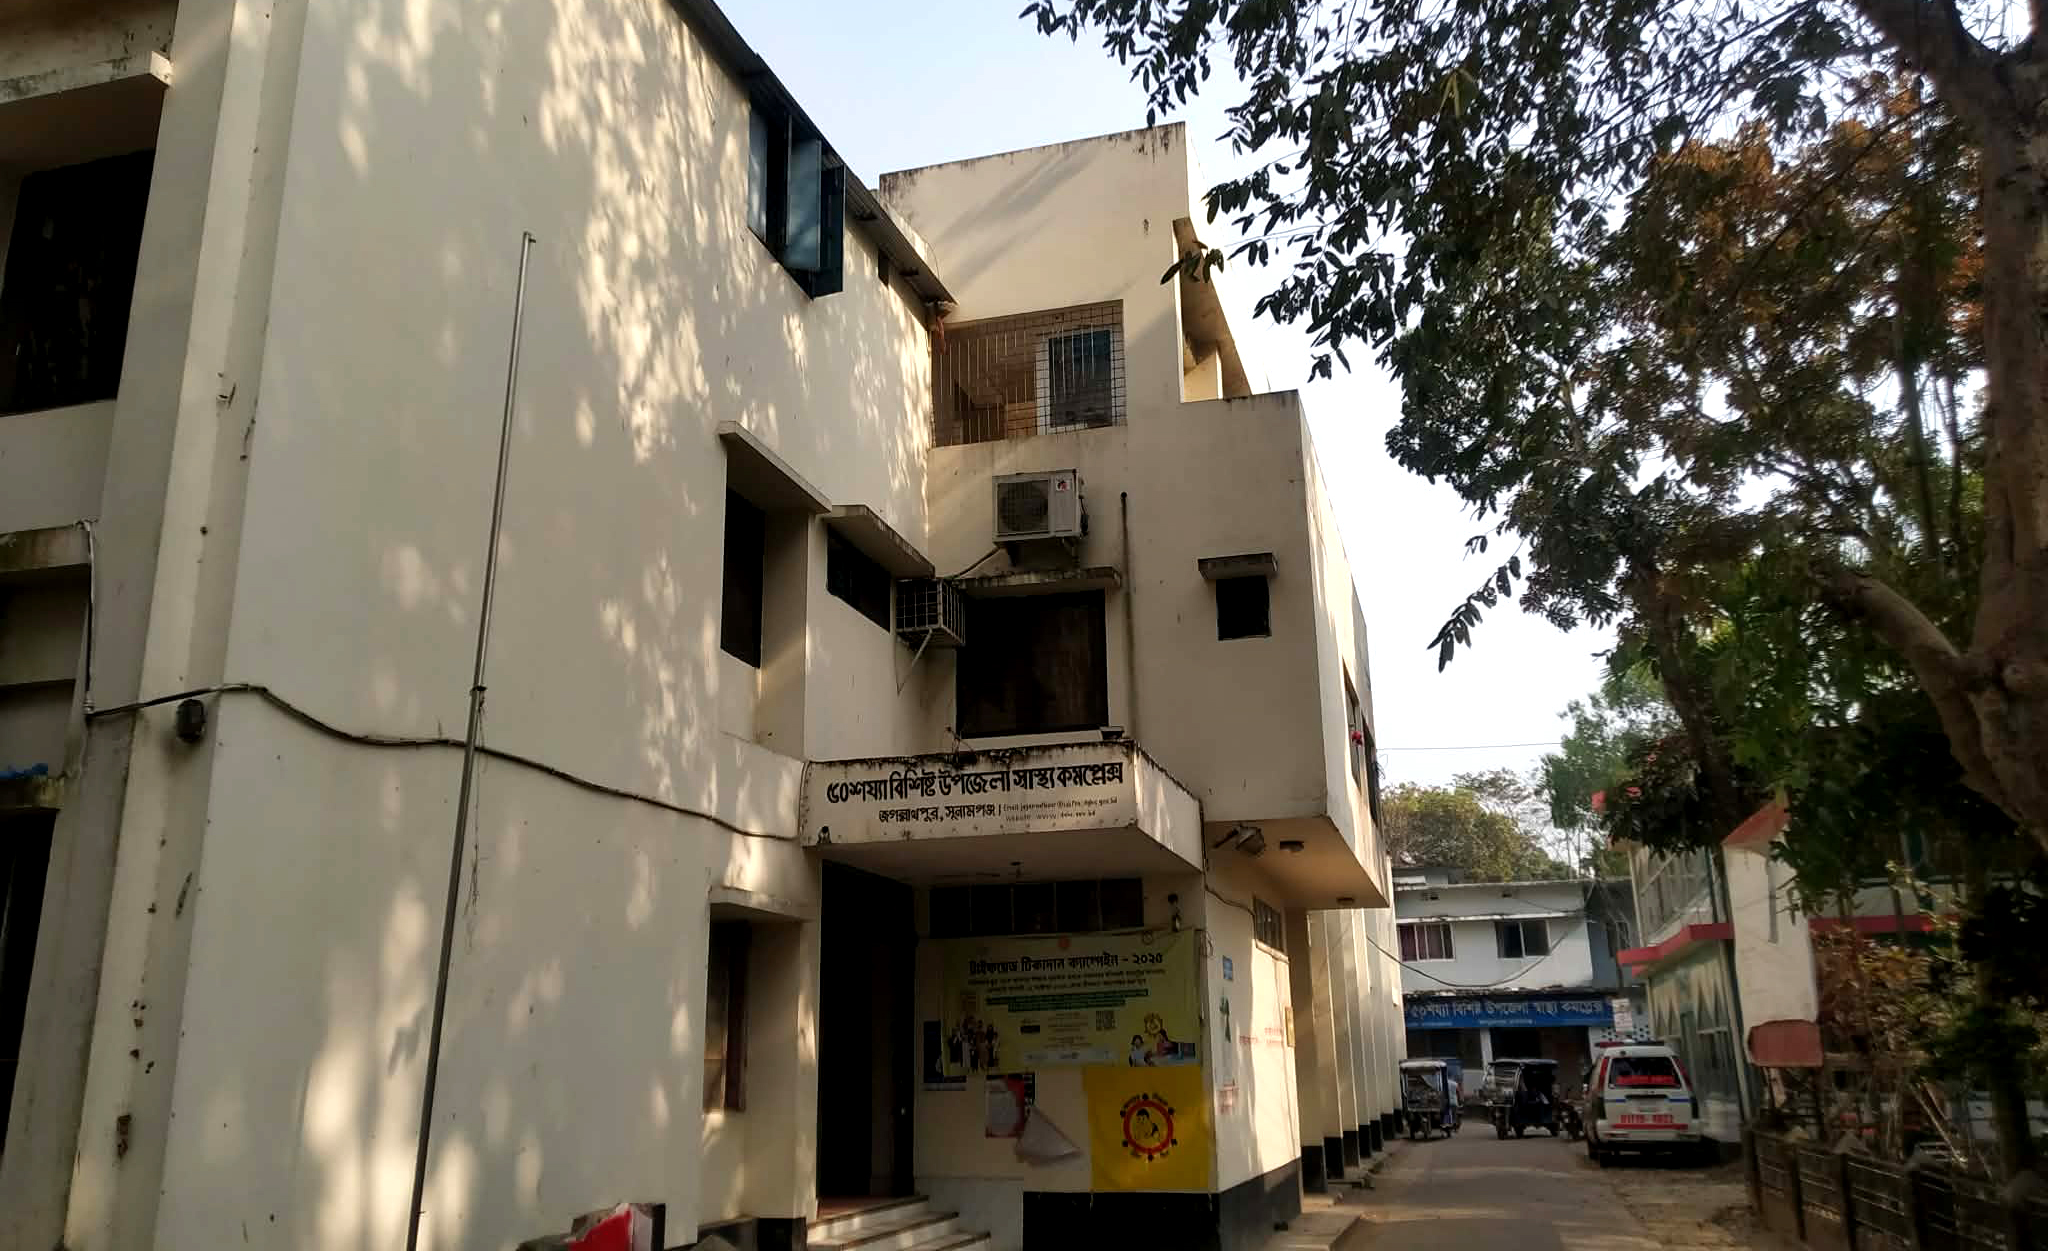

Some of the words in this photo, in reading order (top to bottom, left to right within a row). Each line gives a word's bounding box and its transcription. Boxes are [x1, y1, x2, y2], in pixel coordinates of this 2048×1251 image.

[889, 769, 936, 800] বিশিষ্ট
[938, 768, 1010, 796] উপজেলা
[1012, 767, 1055, 790] স্বাস্থ্য
[1057, 762, 1123, 788] কমপ্লেক্স
